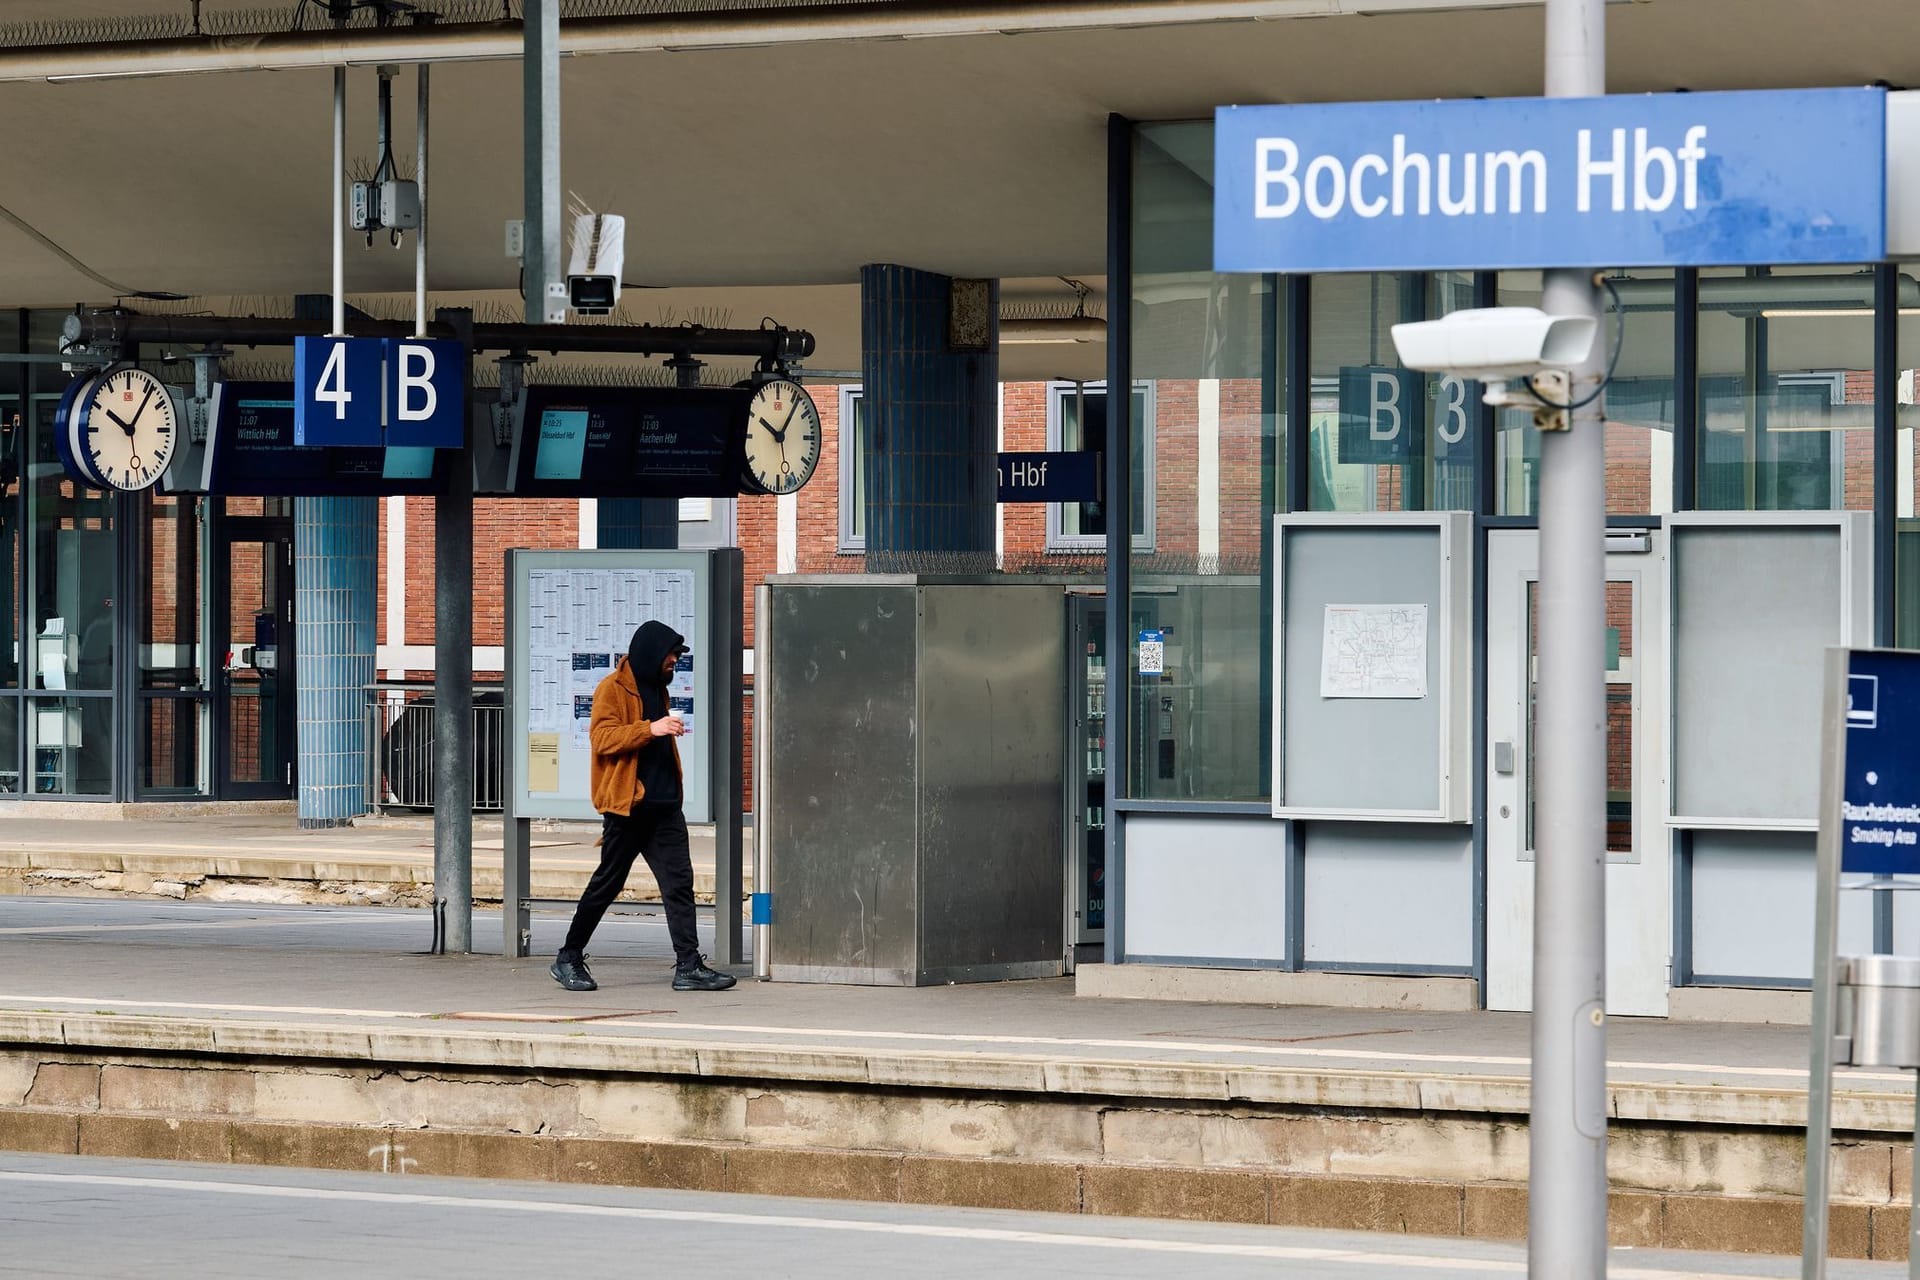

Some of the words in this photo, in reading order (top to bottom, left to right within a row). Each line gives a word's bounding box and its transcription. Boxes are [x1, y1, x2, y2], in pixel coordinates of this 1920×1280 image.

[1254, 134, 1548, 220] Bochum
[1576, 125, 1708, 212] Hbf
[314, 342, 352, 420] 4
[397, 344, 437, 421] B
[239, 415, 258, 426] 11:07
[1369, 373, 1401, 440] B
[1438, 375, 1467, 444] 3
[237, 428, 265, 441] Wittlich
[265, 428, 280, 441] Hbf
[640, 432, 665, 445] Aachen
[664, 432, 678, 444] Hbf
[1010, 461, 1048, 488] Hbf
[1851, 826, 1894, 847] Smoking
[1893, 828, 1918, 846] Area
